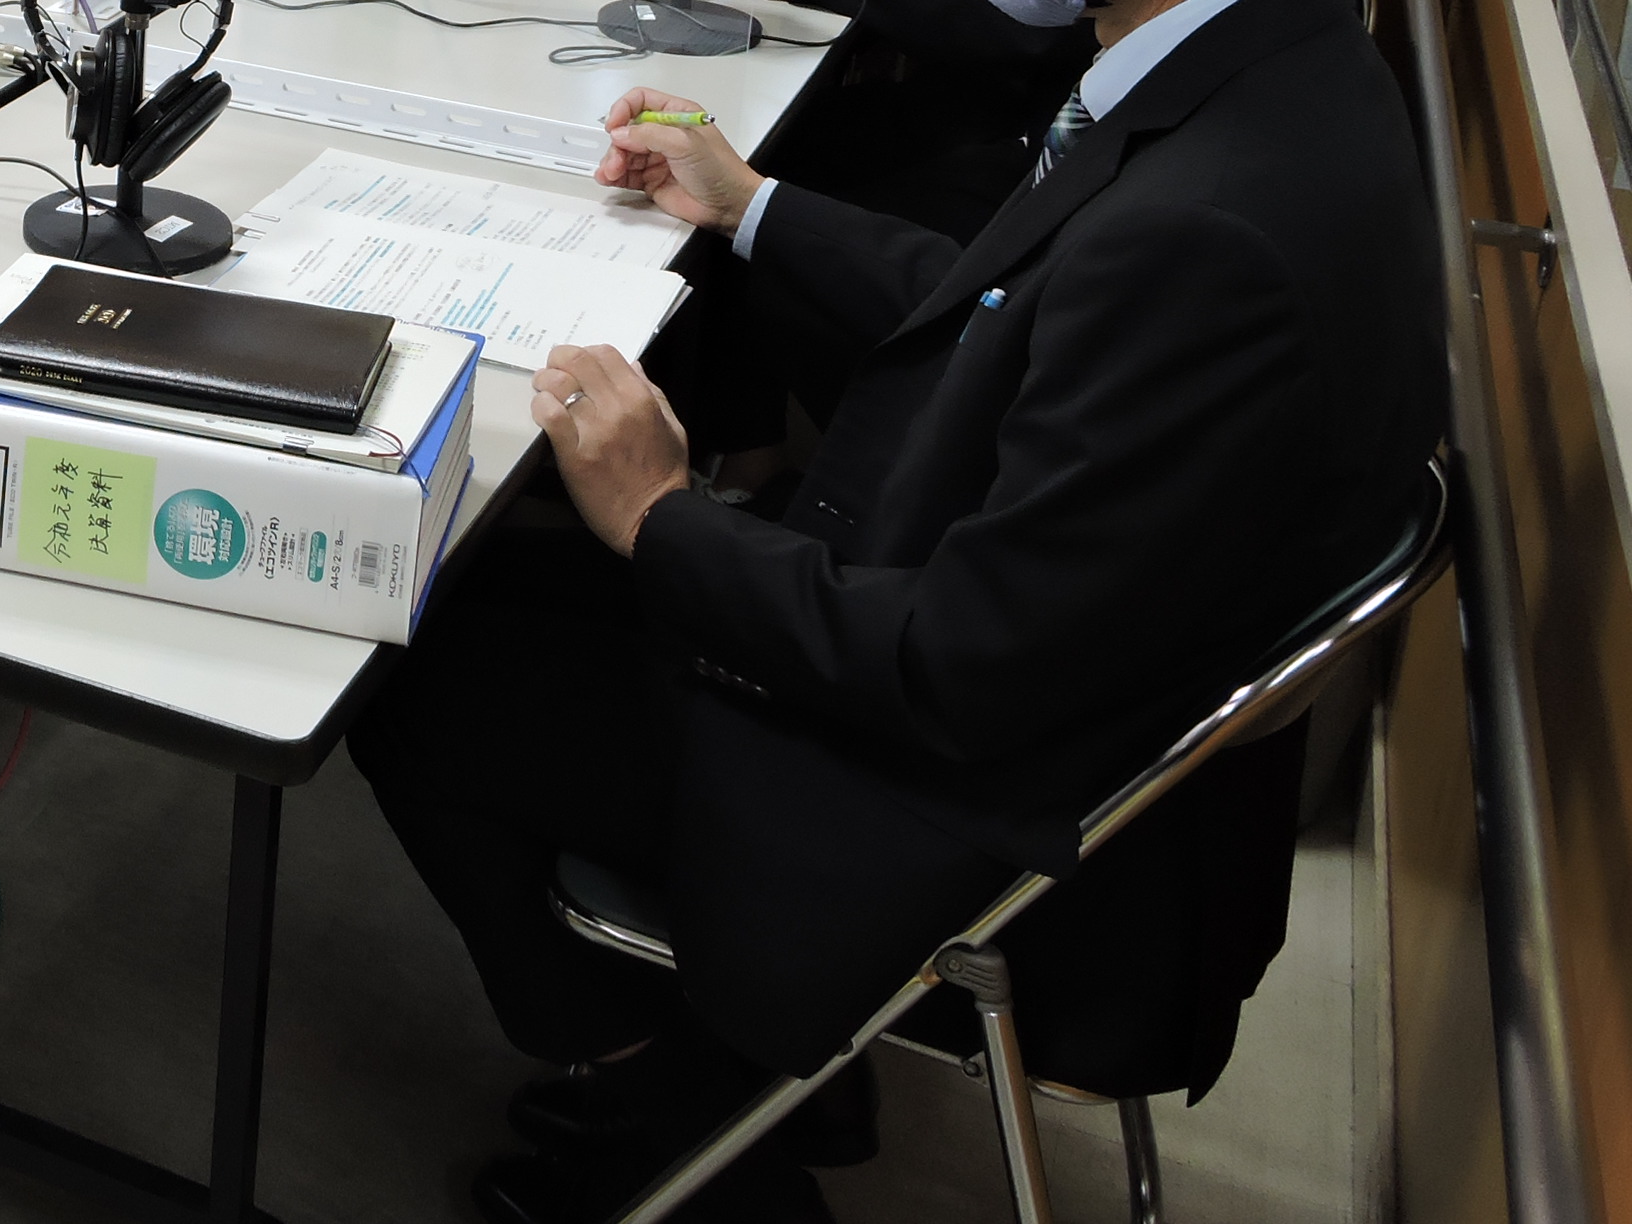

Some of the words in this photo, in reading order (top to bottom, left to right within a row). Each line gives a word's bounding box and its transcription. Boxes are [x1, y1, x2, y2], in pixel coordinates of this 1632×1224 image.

[19, 365, 43, 377] 2020
[188, 505, 221, 565] 環境
[388, 543, 401, 598] KOKUYO
